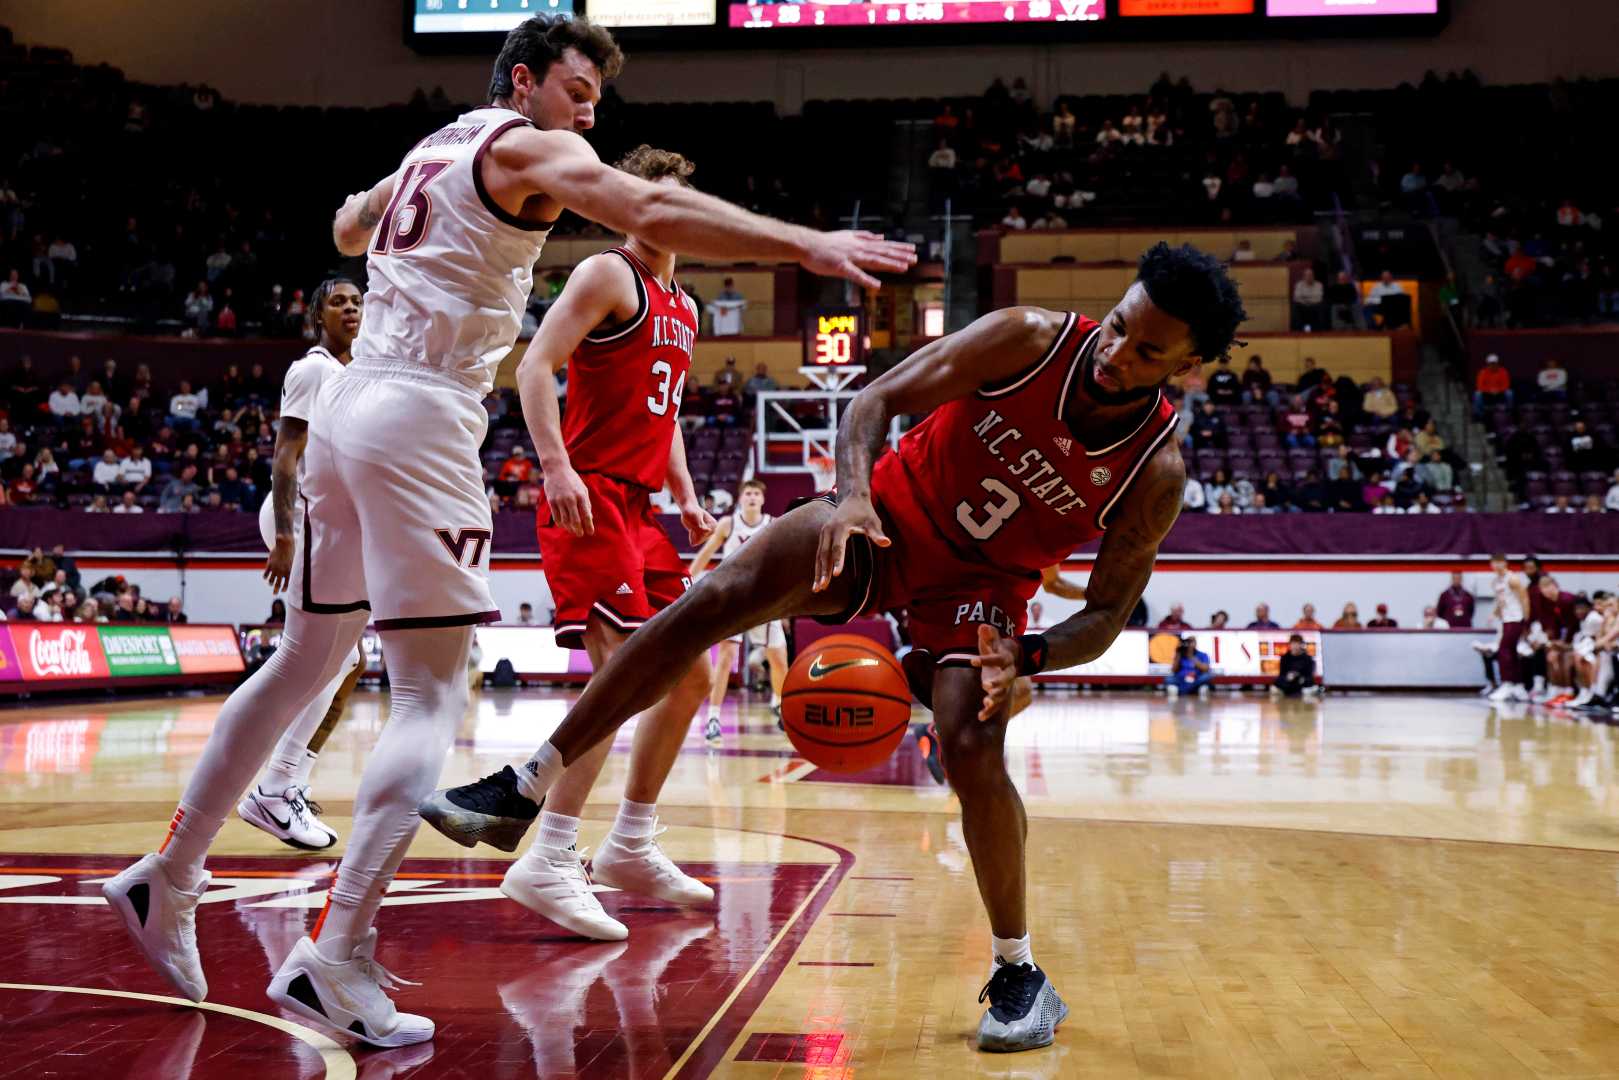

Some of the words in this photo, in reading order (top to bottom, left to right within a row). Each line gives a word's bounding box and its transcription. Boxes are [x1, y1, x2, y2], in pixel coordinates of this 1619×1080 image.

[371, 159, 455, 256] 13
[815, 333, 851, 363] 30
[647, 360, 686, 424] 34
[973, 409, 1023, 463] N.C.
[1007, 448, 1089, 516] STATE
[956, 477, 1021, 541] 3
[432, 527, 492, 568] VT
[954, 600, 1016, 638] PACK
[804, 703, 874, 727] ELITE
